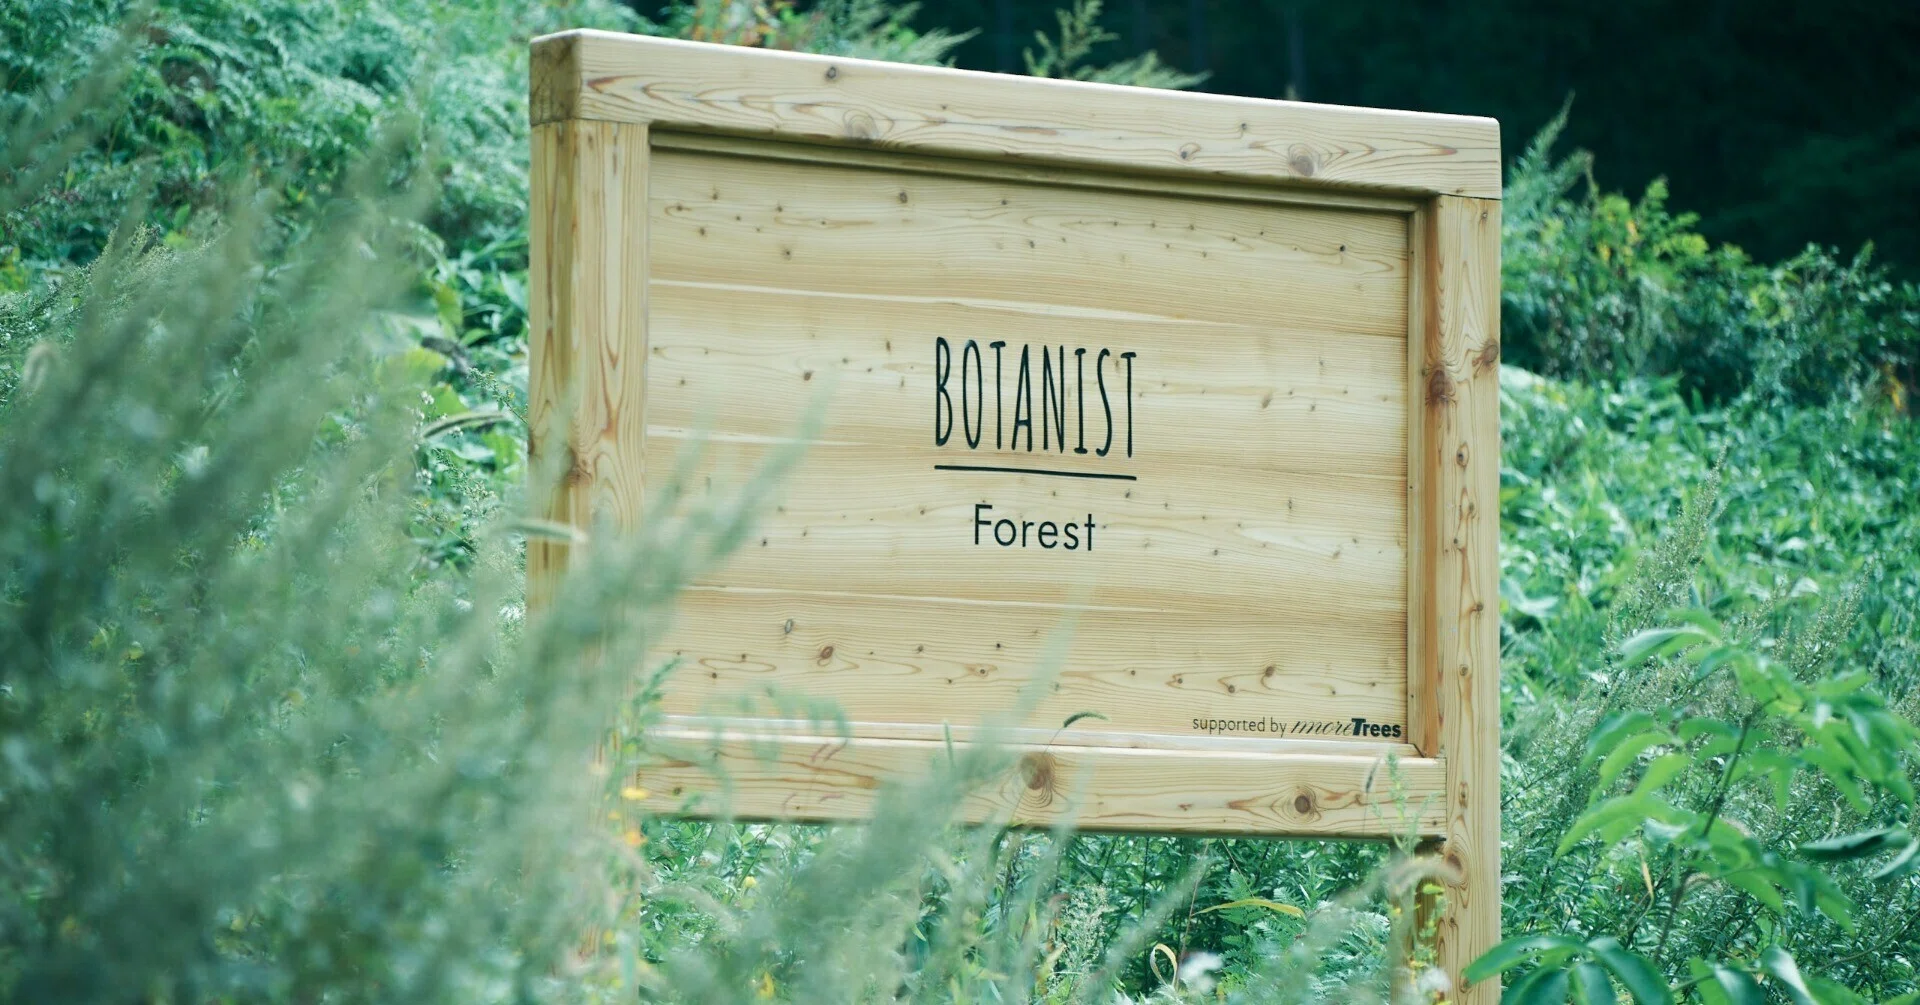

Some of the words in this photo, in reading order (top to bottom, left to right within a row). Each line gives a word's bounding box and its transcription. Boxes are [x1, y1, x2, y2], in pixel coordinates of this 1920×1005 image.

[935, 336, 1137, 458] BOTANIST
[974, 503, 1096, 551] Forest
[1192, 717, 1266, 735] supported
[1270, 717, 1288, 738] by
